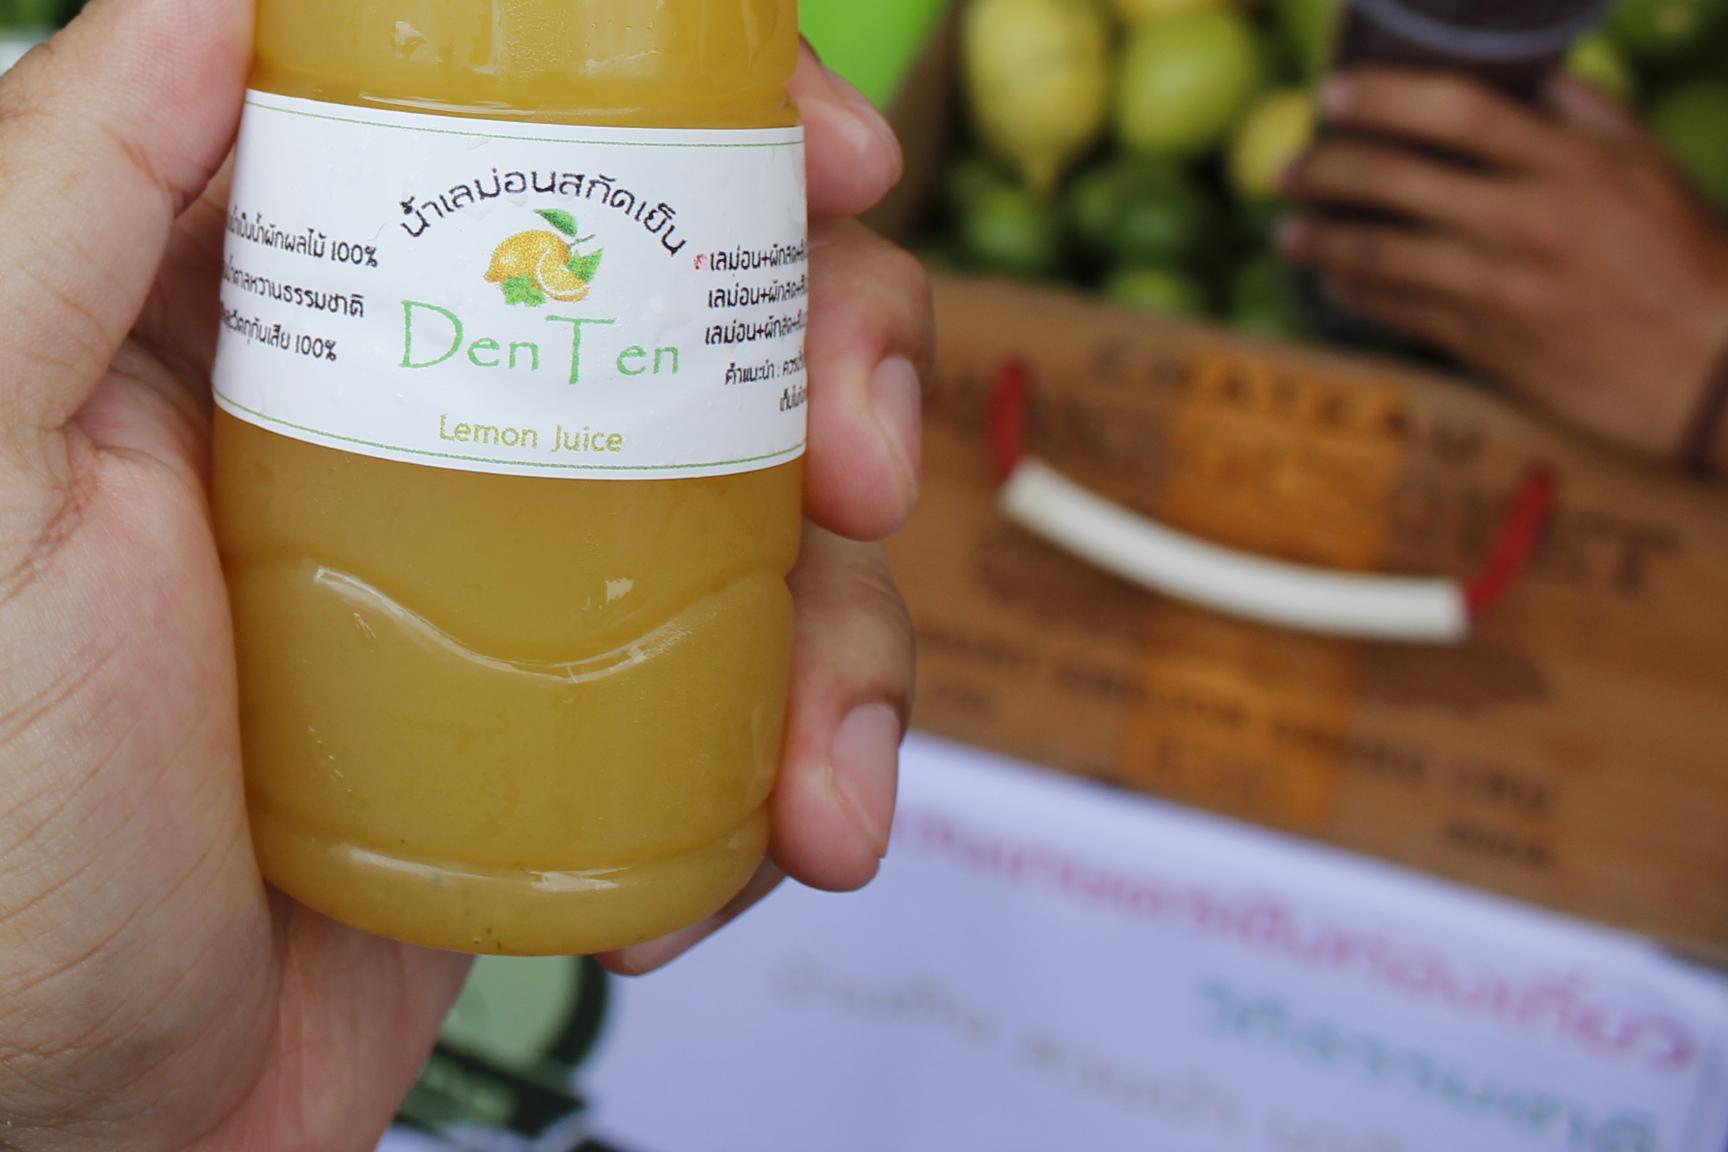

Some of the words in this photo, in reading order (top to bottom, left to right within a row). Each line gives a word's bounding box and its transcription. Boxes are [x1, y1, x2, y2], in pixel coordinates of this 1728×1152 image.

[400, 167, 688, 257] น้ำเลม่อนสกัดเย็น
[331, 241, 379, 268] 100%
[295, 334, 337, 361] 100%
[399, 299, 540, 373] Den
[439, 414, 538, 449] Lemon
[553, 417, 624, 453] Juice
